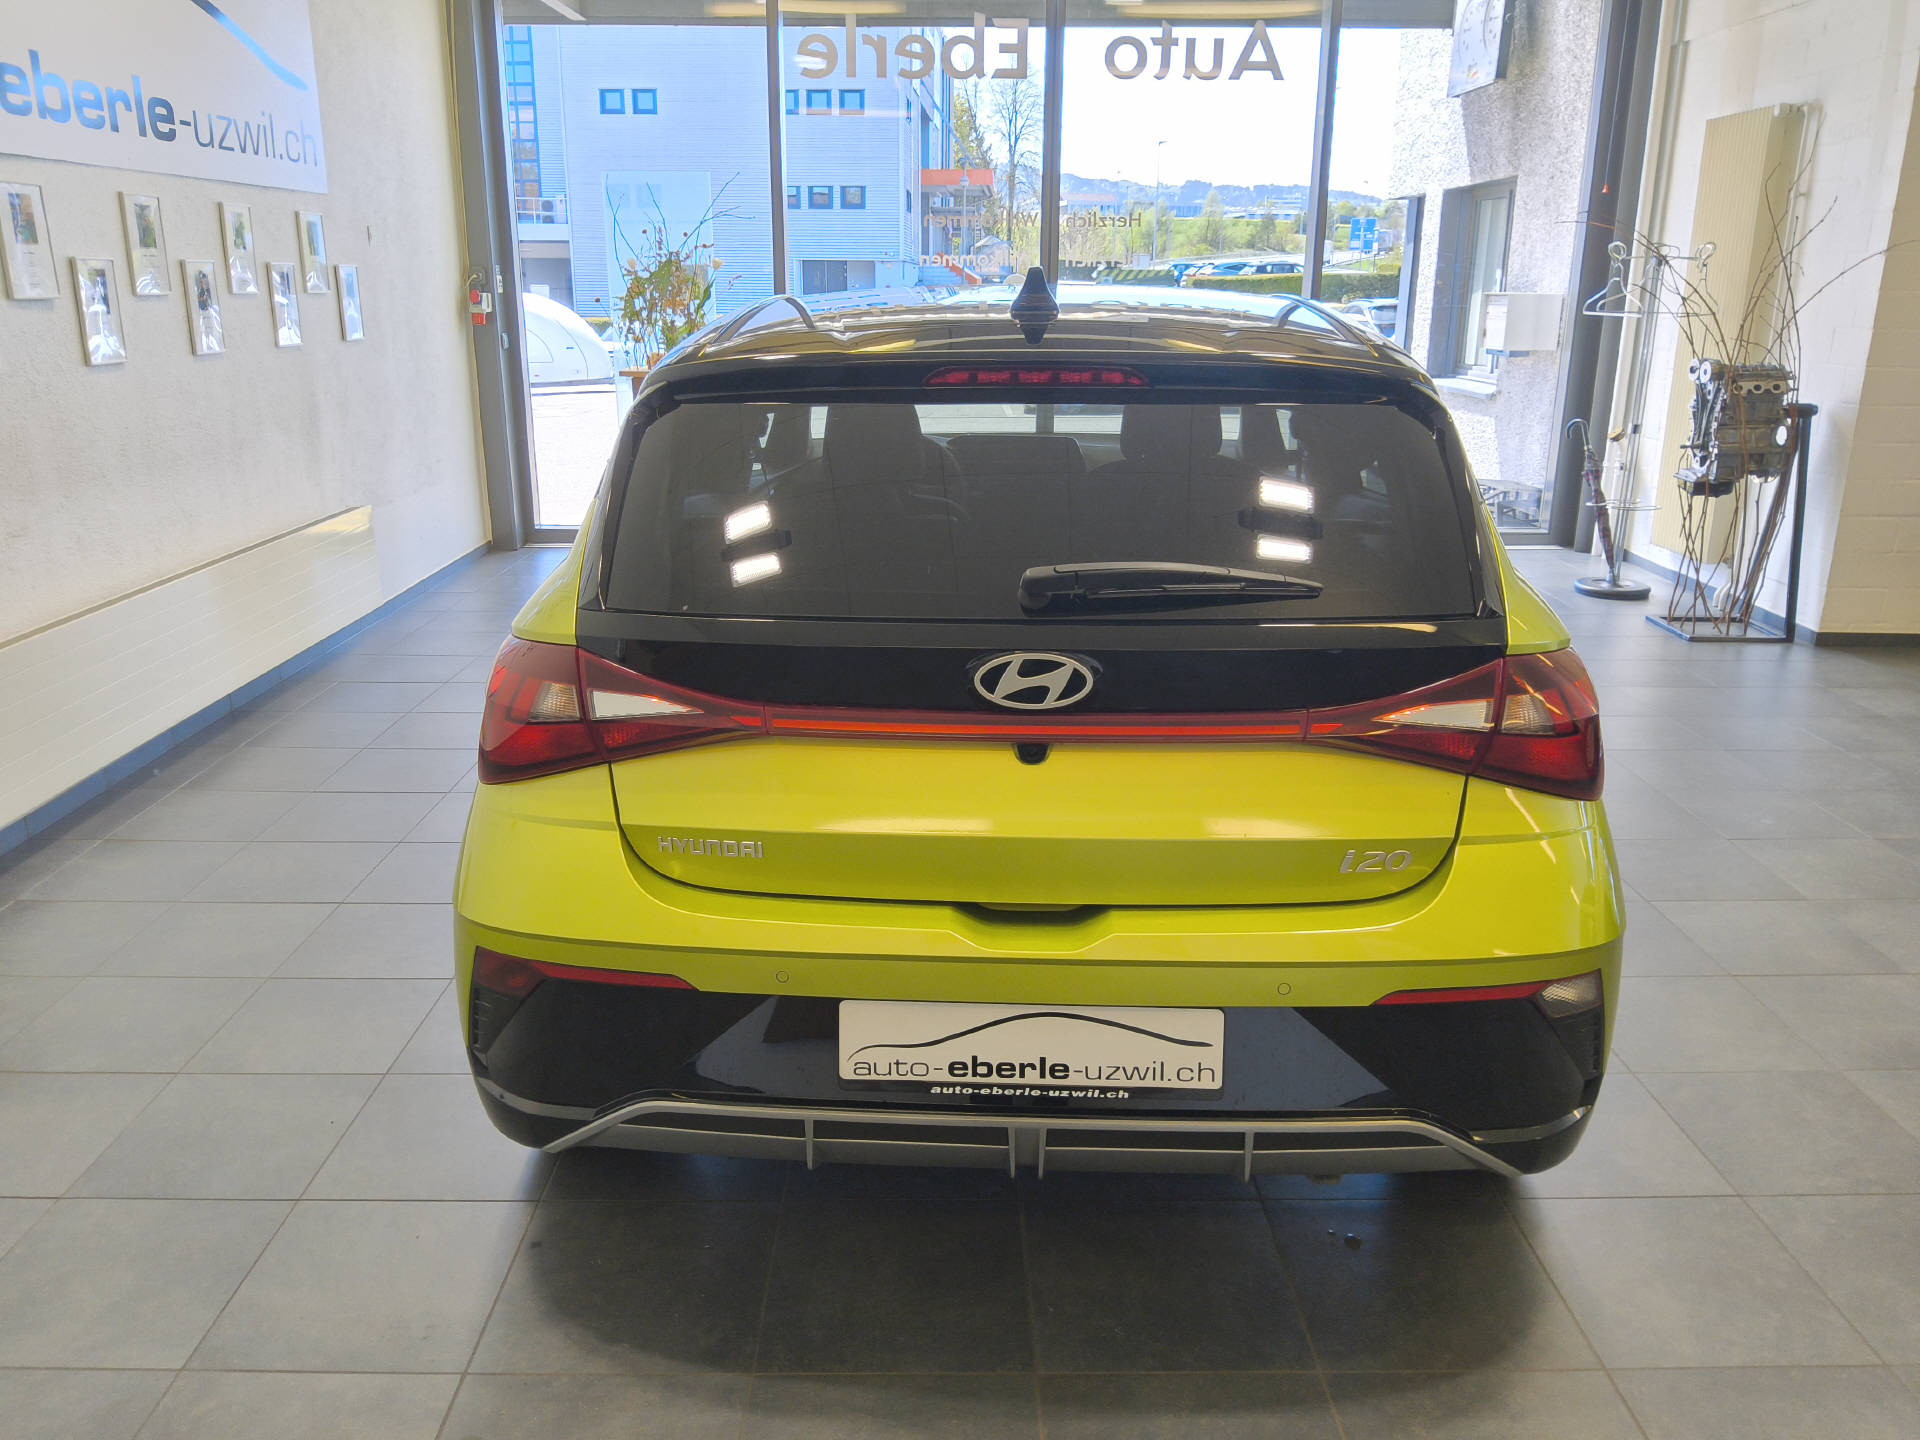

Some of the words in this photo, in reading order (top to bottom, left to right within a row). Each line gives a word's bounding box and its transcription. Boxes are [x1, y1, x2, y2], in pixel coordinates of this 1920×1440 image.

[657, 836, 763, 859] HYUNDAI
[1339, 849, 1413, 874] i20
[853, 1055, 1216, 1083] auto-eberle-uzwil.ch
[930, 1084, 1129, 1100] auto-eberle-uzwil.ch
